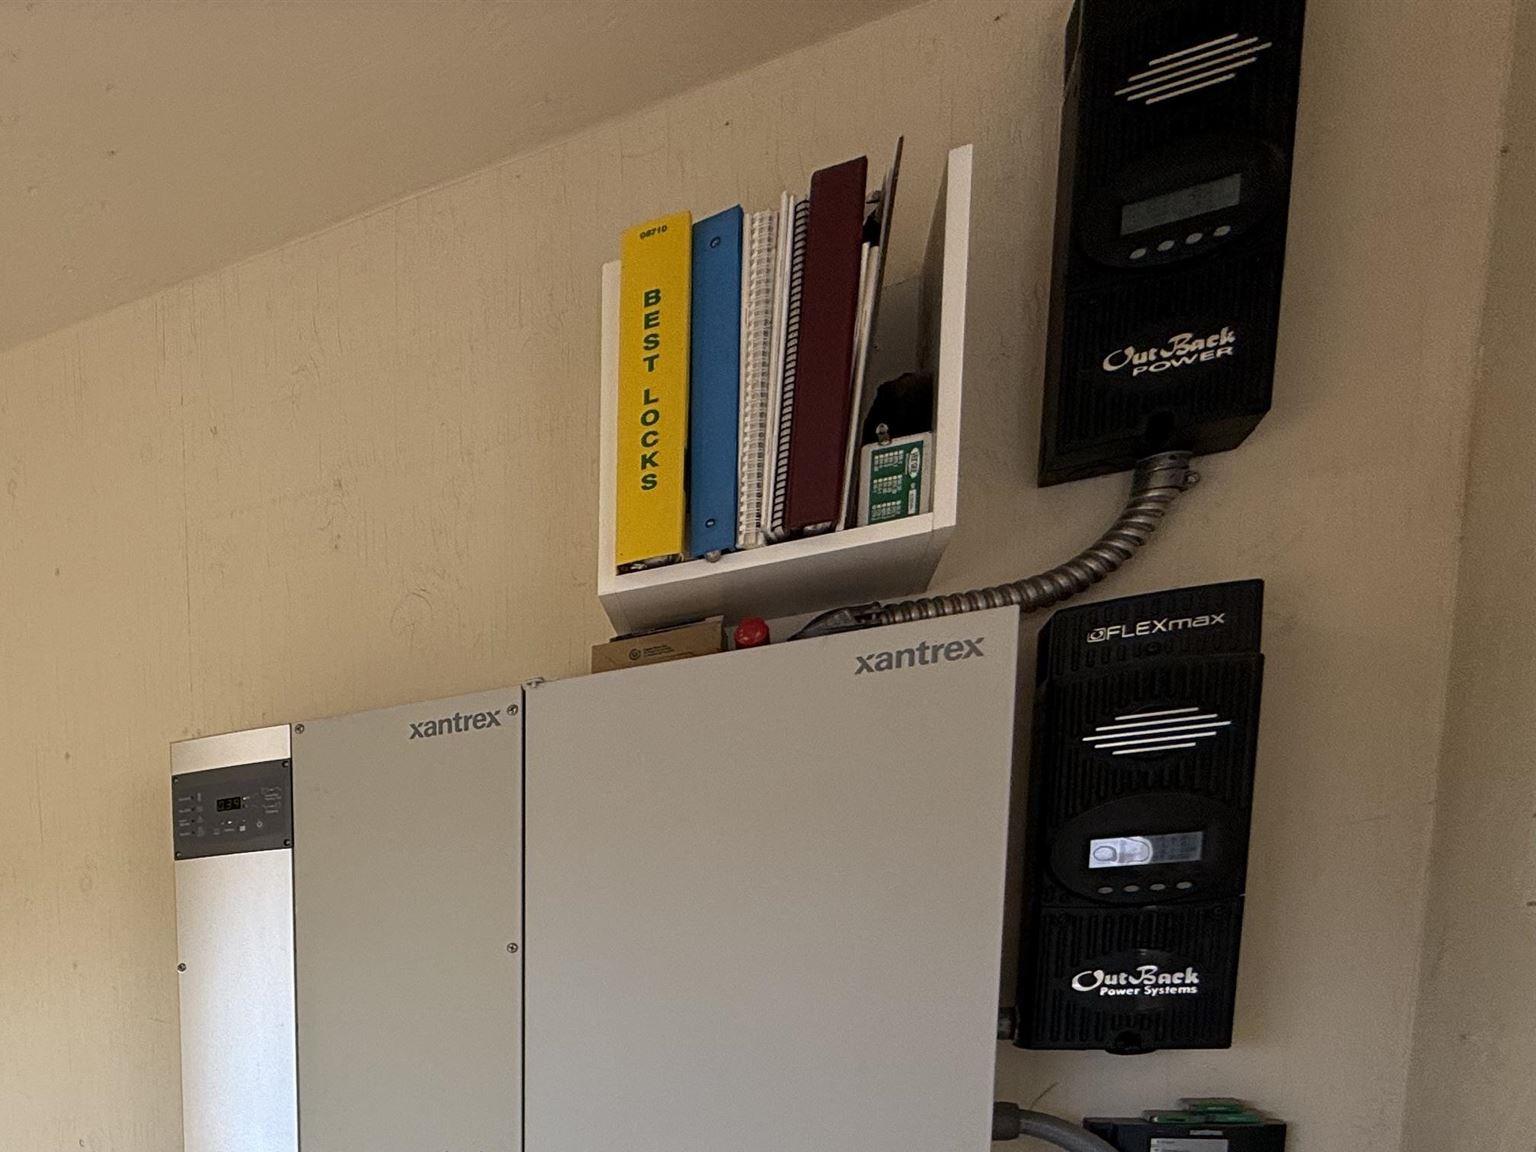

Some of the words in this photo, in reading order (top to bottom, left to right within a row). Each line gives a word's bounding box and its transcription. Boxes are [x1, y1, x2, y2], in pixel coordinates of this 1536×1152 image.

[642, 288, 662, 374] BEST
[1131, 346, 1234, 377] POWER
[640, 388, 661, 491] LOCKS
[1106, 613, 1226, 641] FLEXmax
[854, 636, 985, 676] xantrex
[409, 709, 502, 740] xantrex
[1100, 986, 1140, 997] Power
[1144, 985, 1198, 997] Systems
